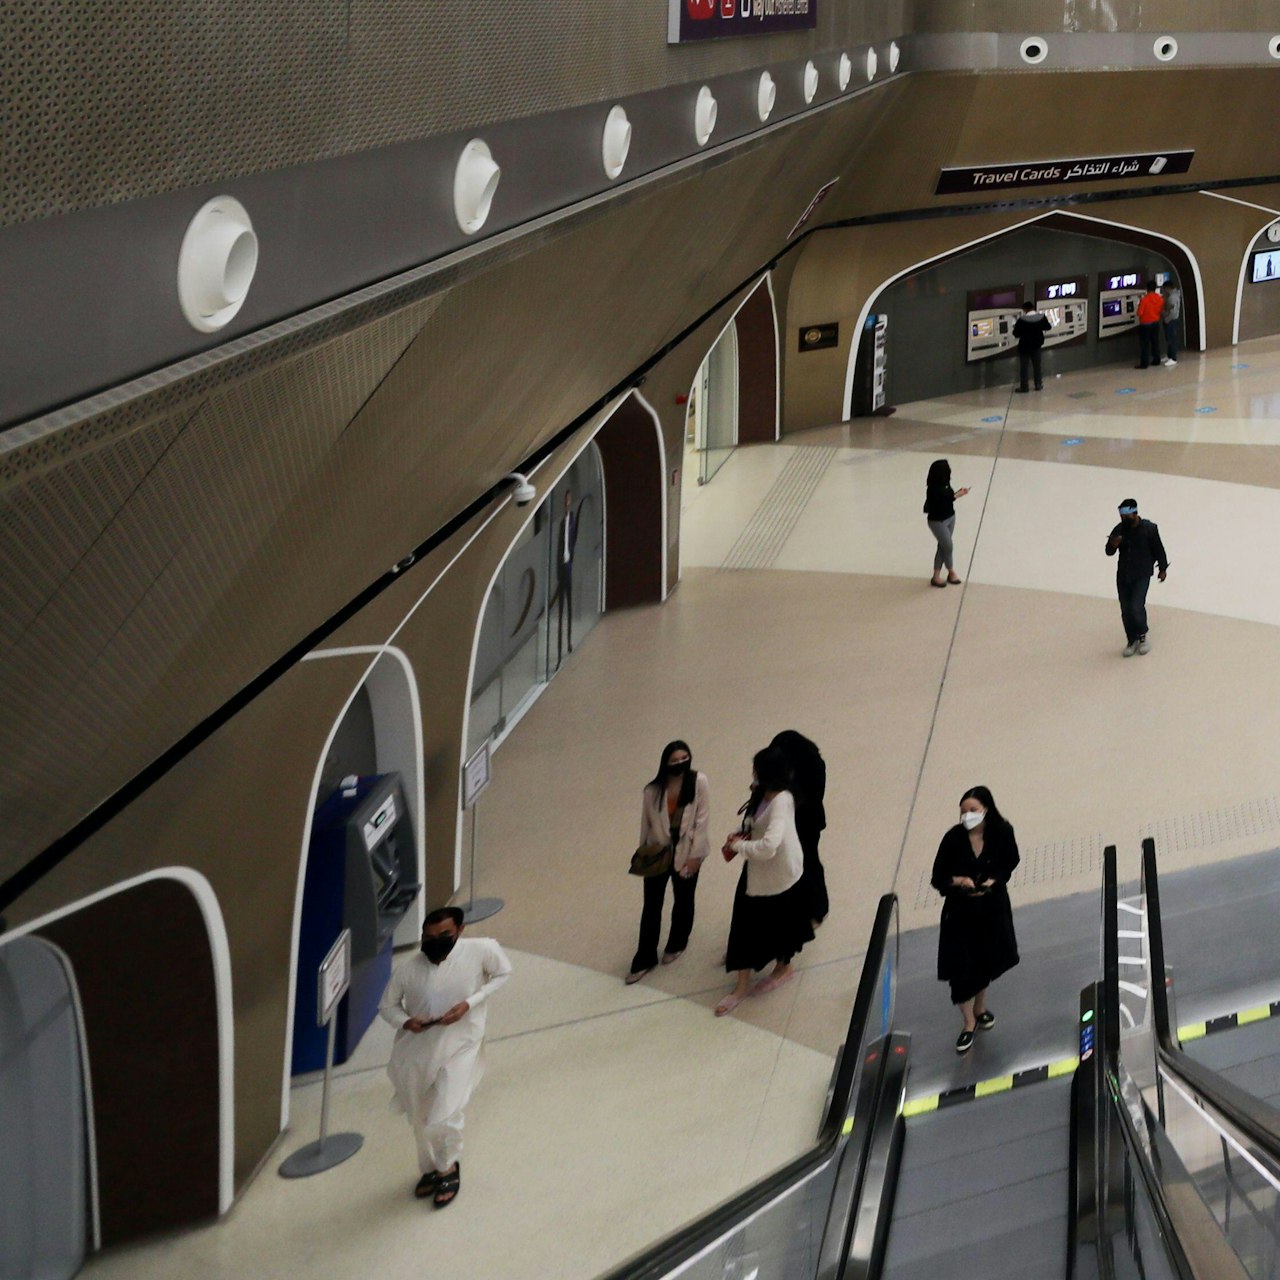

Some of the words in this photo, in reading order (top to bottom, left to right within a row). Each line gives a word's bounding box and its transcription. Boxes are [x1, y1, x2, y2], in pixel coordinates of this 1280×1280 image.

[972, 169, 1019, 185] Travel
[1020, 166, 1061, 182] Cards
[1063, 162, 1109, 180] التذاكر
[1111, 159, 1140, 176] شراء
